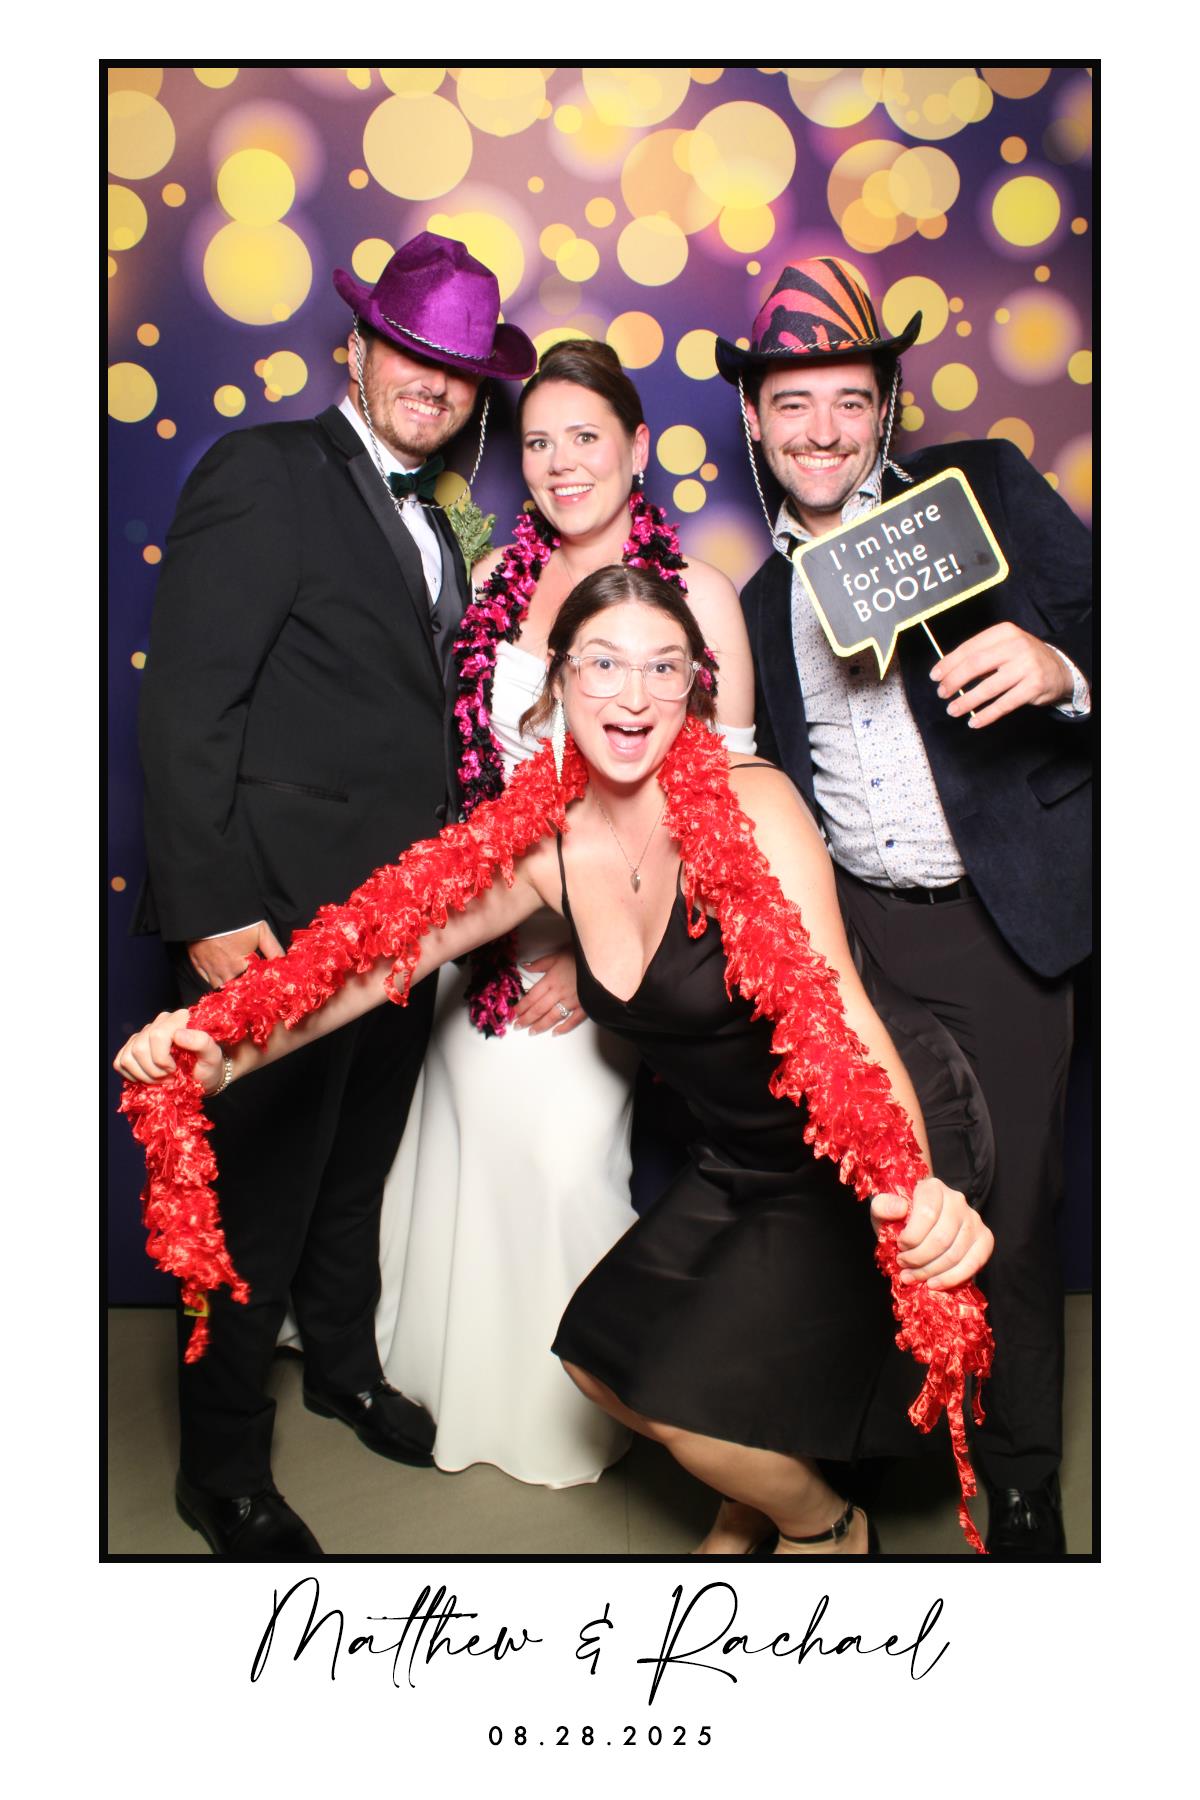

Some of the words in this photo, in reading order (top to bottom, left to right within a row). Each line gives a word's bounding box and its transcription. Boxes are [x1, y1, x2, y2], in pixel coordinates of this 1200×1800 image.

[829, 536, 881, 571] I'm
[880, 504, 941, 545] here
[842, 566, 880, 597] for
[885, 543, 928, 575] the
[853, 553, 962, 623] BOOZE!
